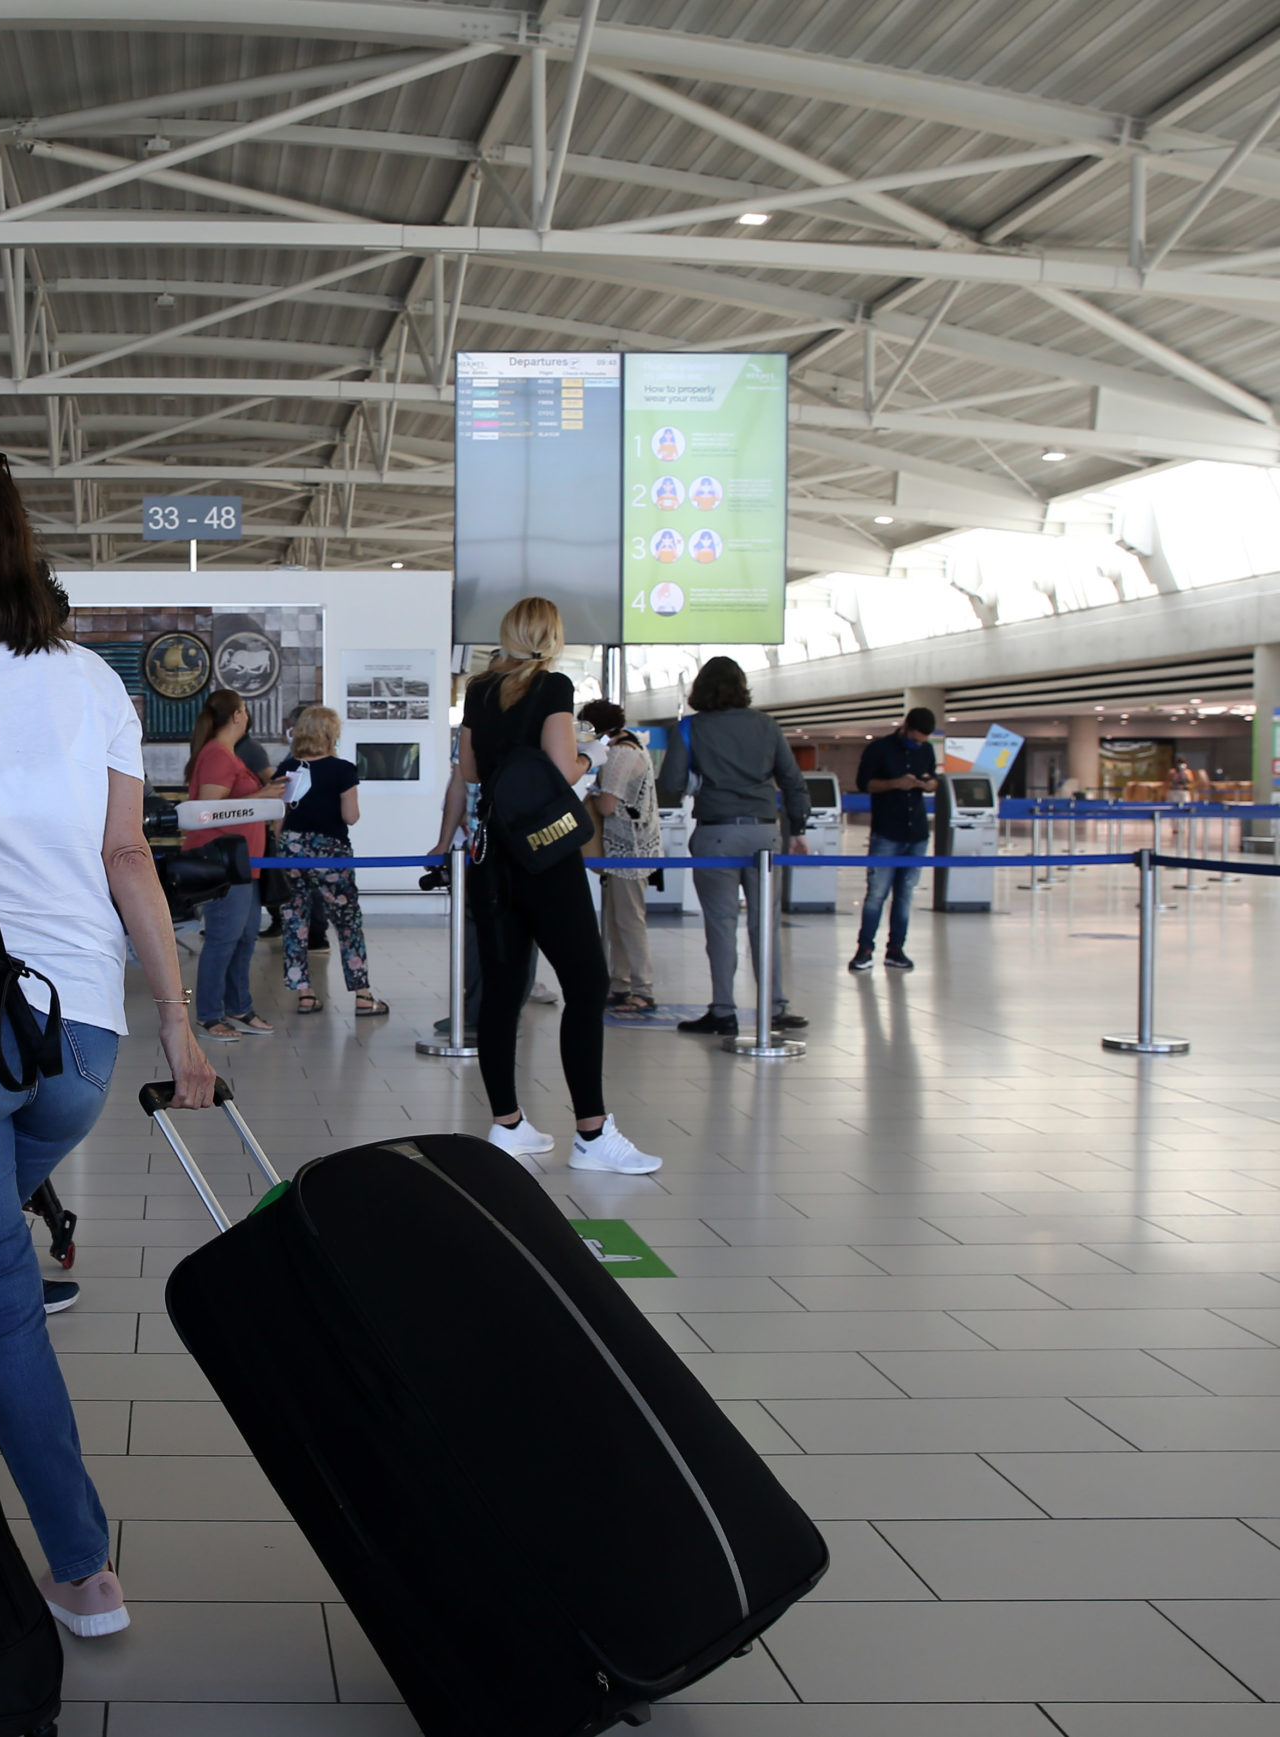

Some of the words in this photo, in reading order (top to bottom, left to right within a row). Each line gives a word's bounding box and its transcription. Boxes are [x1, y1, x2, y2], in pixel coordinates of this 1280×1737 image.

[509, 357, 568, 367] Departures
[644, 385, 664, 393] How
[667, 385, 676, 393] to
[678, 385, 716, 395] properly
[633, 435, 641, 458] 1
[631, 484, 647, 508] 2
[149, 507, 179, 529] 33
[204, 507, 235, 529] 48
[631, 537, 646, 560] 3
[631, 591, 646, 613] 4
[212, 808, 254, 820] REUTERS
[527, 812, 578, 851] PUMA
